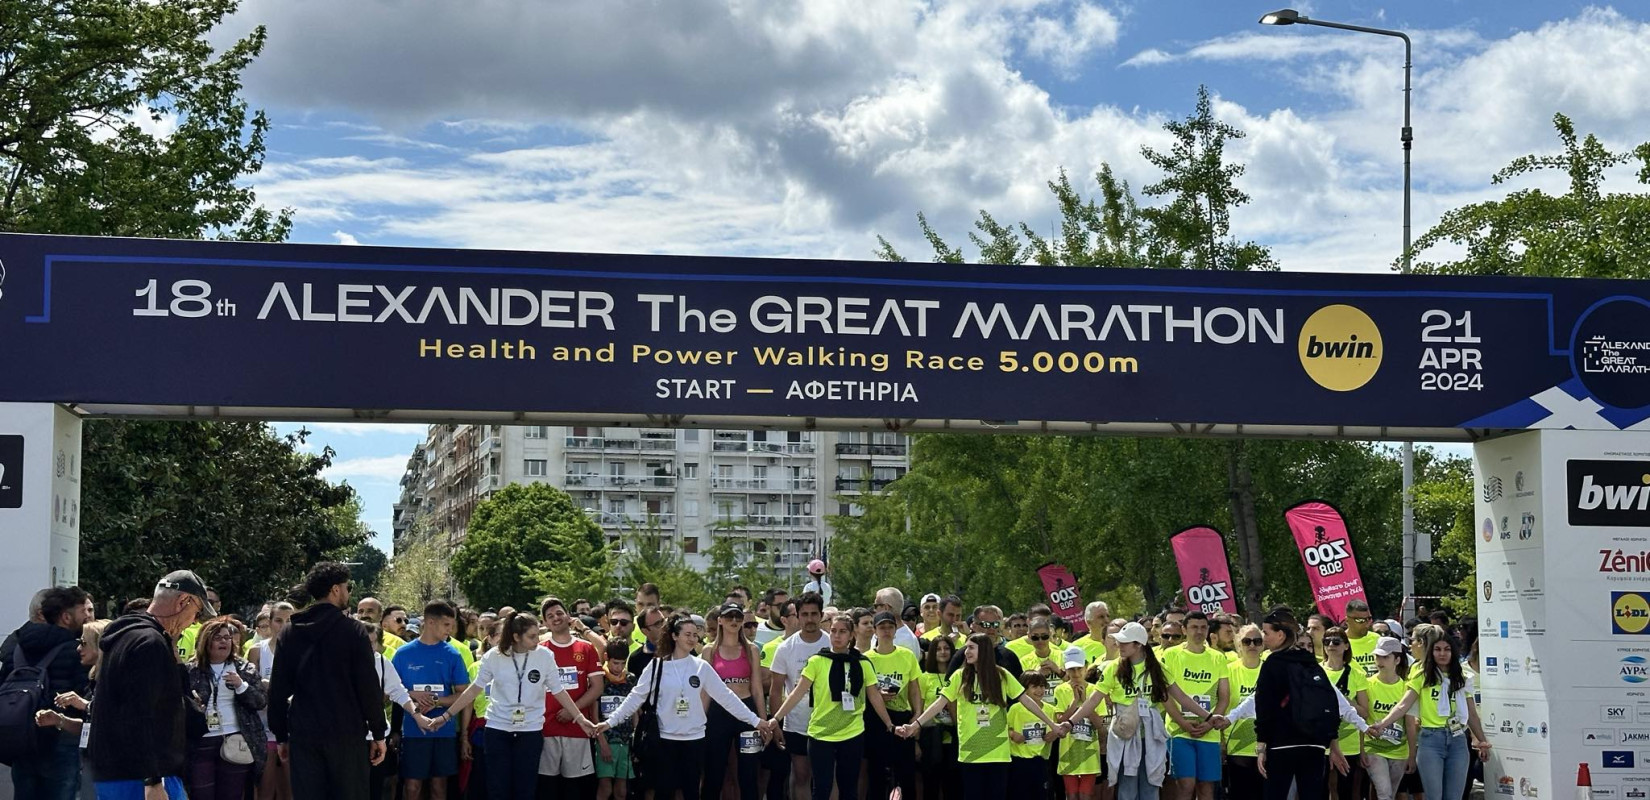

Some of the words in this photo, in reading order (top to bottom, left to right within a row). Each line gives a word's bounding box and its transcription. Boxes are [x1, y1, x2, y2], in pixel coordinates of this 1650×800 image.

[133, 279, 236, 317] 18th
[257, 282, 615, 330] ALEXANDER
[638, 293, 737, 332] The
[750, 295, 940, 337] GREAT
[952, 302, 1285, 344] MARATHON
[1420, 310, 1482, 343] 21
[419, 338, 536, 360] Health
[552, 343, 615, 362] and
[632, 345, 738, 365] Power
[753, 346, 890, 372] Walking
[905, 350, 985, 370] Race
[998, 351, 1138, 373] 5.000m
[1306, 334, 1378, 360] bwin
[1418, 348, 1483, 370] APR
[1601, 356, 1637, 365] GREAT
[655, 377, 737, 399] START
[785, 380, 919, 403] ΑΦΕΤΗΡΙΑ
[1420, 372, 1484, 392] 2024
[1183, 668, 1212, 679] bwin
[1607, 708, 1625, 716] SKY
